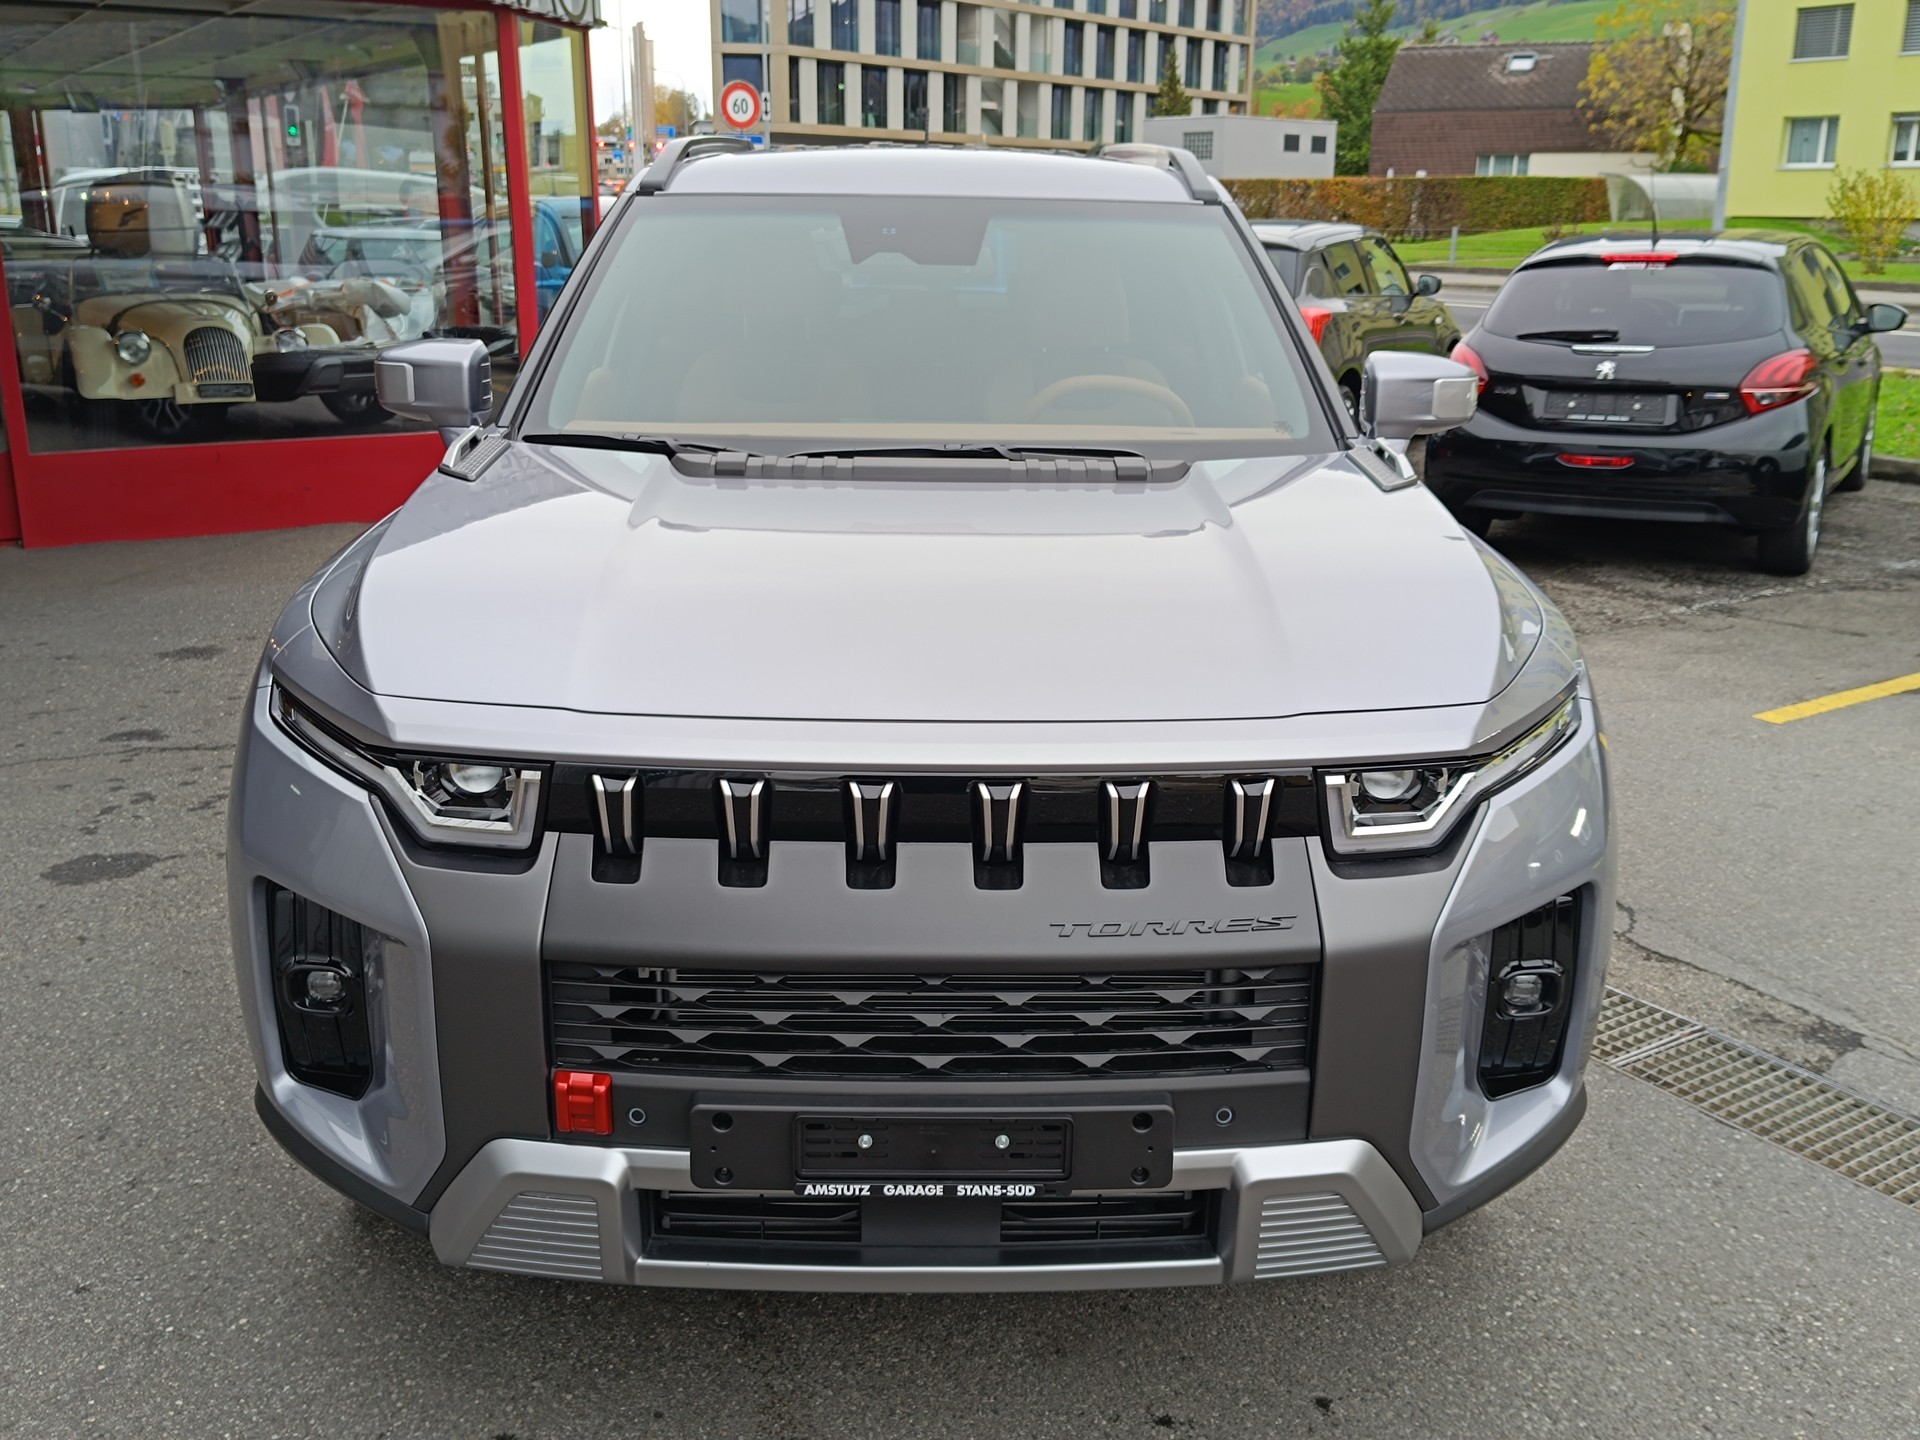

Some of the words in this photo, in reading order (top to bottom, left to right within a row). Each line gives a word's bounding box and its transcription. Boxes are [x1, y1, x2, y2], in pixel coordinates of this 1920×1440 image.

[732, 97, 749, 115] 60
[1049, 914, 1298, 938] TORRES
[803, 1183, 871, 1196] AMSTUTZ
[883, 1183, 944, 1197] GARAGE
[956, 1182, 1036, 1198] STANS-SÜD
